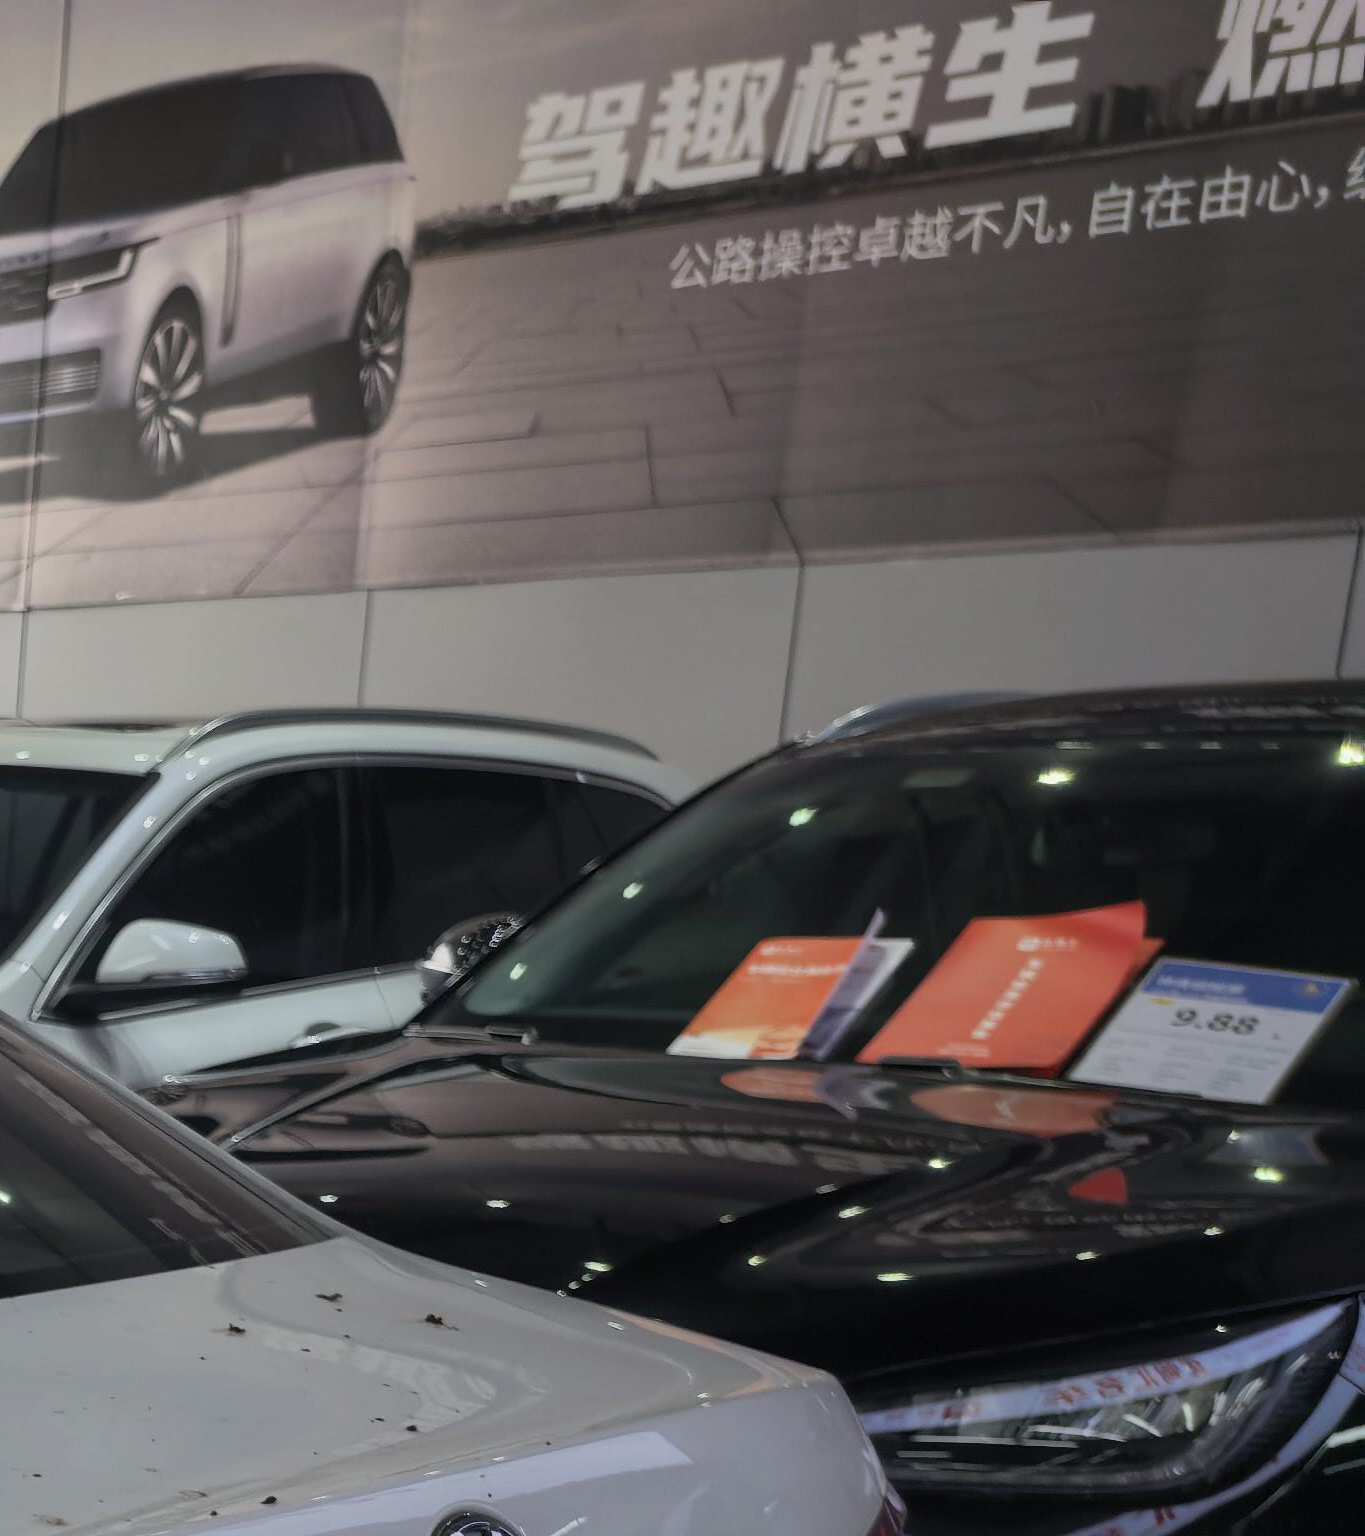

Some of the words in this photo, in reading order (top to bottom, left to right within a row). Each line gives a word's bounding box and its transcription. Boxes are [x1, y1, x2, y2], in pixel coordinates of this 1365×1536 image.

[509, 1, 1097, 212] 驾趣横生
[1171, 1006, 1259, 1035] 9.88
